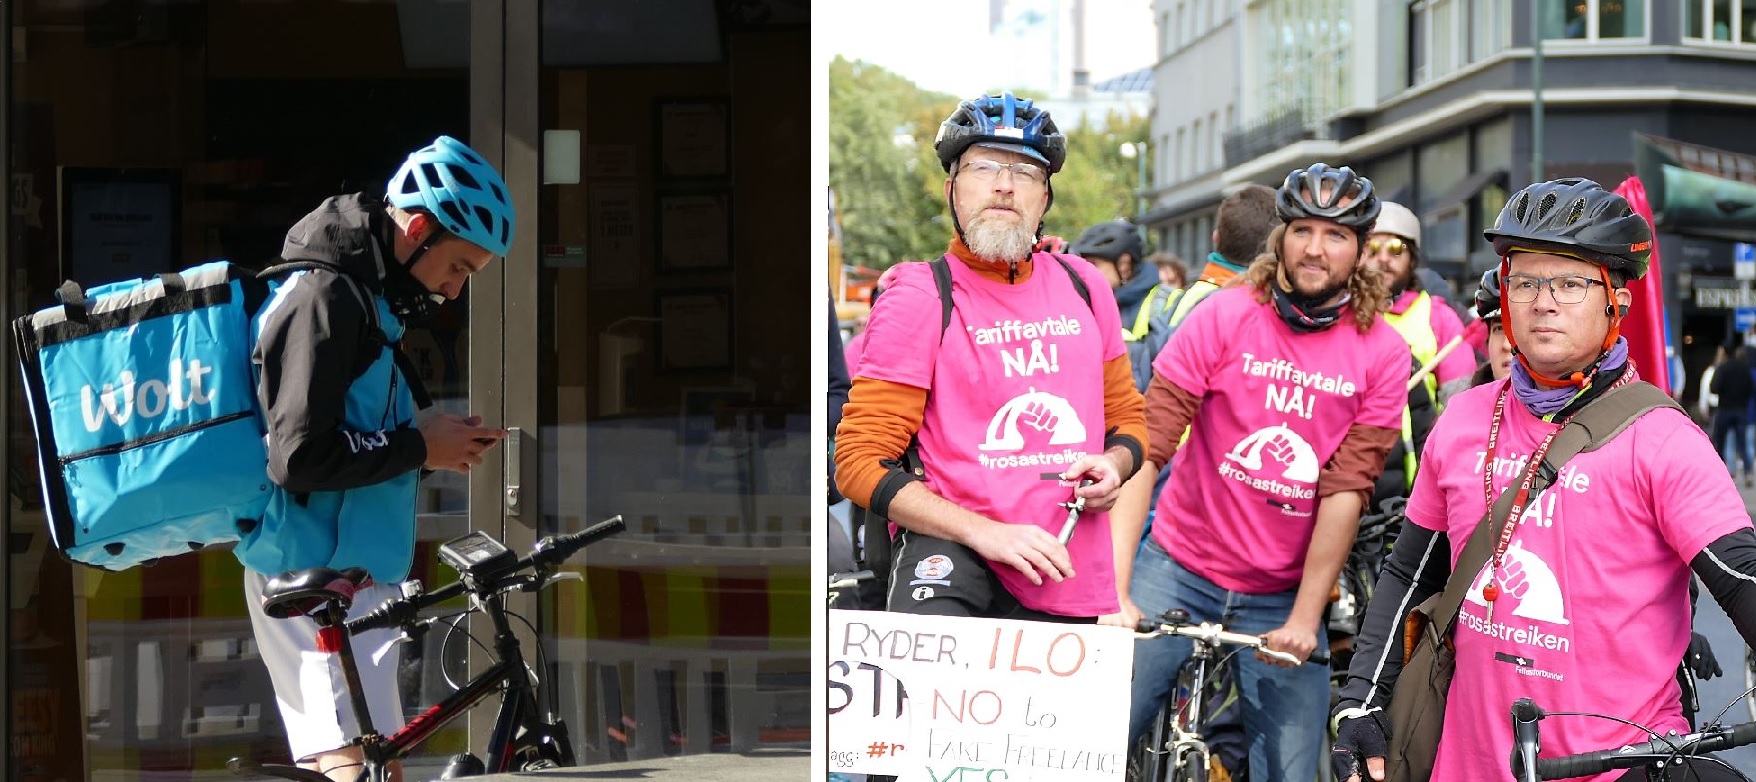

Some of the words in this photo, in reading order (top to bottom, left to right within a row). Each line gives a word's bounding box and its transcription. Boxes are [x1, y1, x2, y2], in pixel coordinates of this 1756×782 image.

[966, 314, 1082, 345] ariffavtale
[1000, 338, 1060, 378] NÅ!
[1242, 352, 1356, 397] Tariffavtale
[80, 357, 216, 433] Wolt
[1265, 382, 1316, 420] NÅ!
[1488, 390, 1508, 450] BREITLING
[978, 448, 1087, 470] #rosastreike
[1459, 606, 1570, 653] #rosastreiken
[932, 689, 1002, 725] NO
[1025, 696, 1057, 729] to
[928, 727, 993, 763] FAKE
[1004, 733, 1125, 775] FREELANCE
